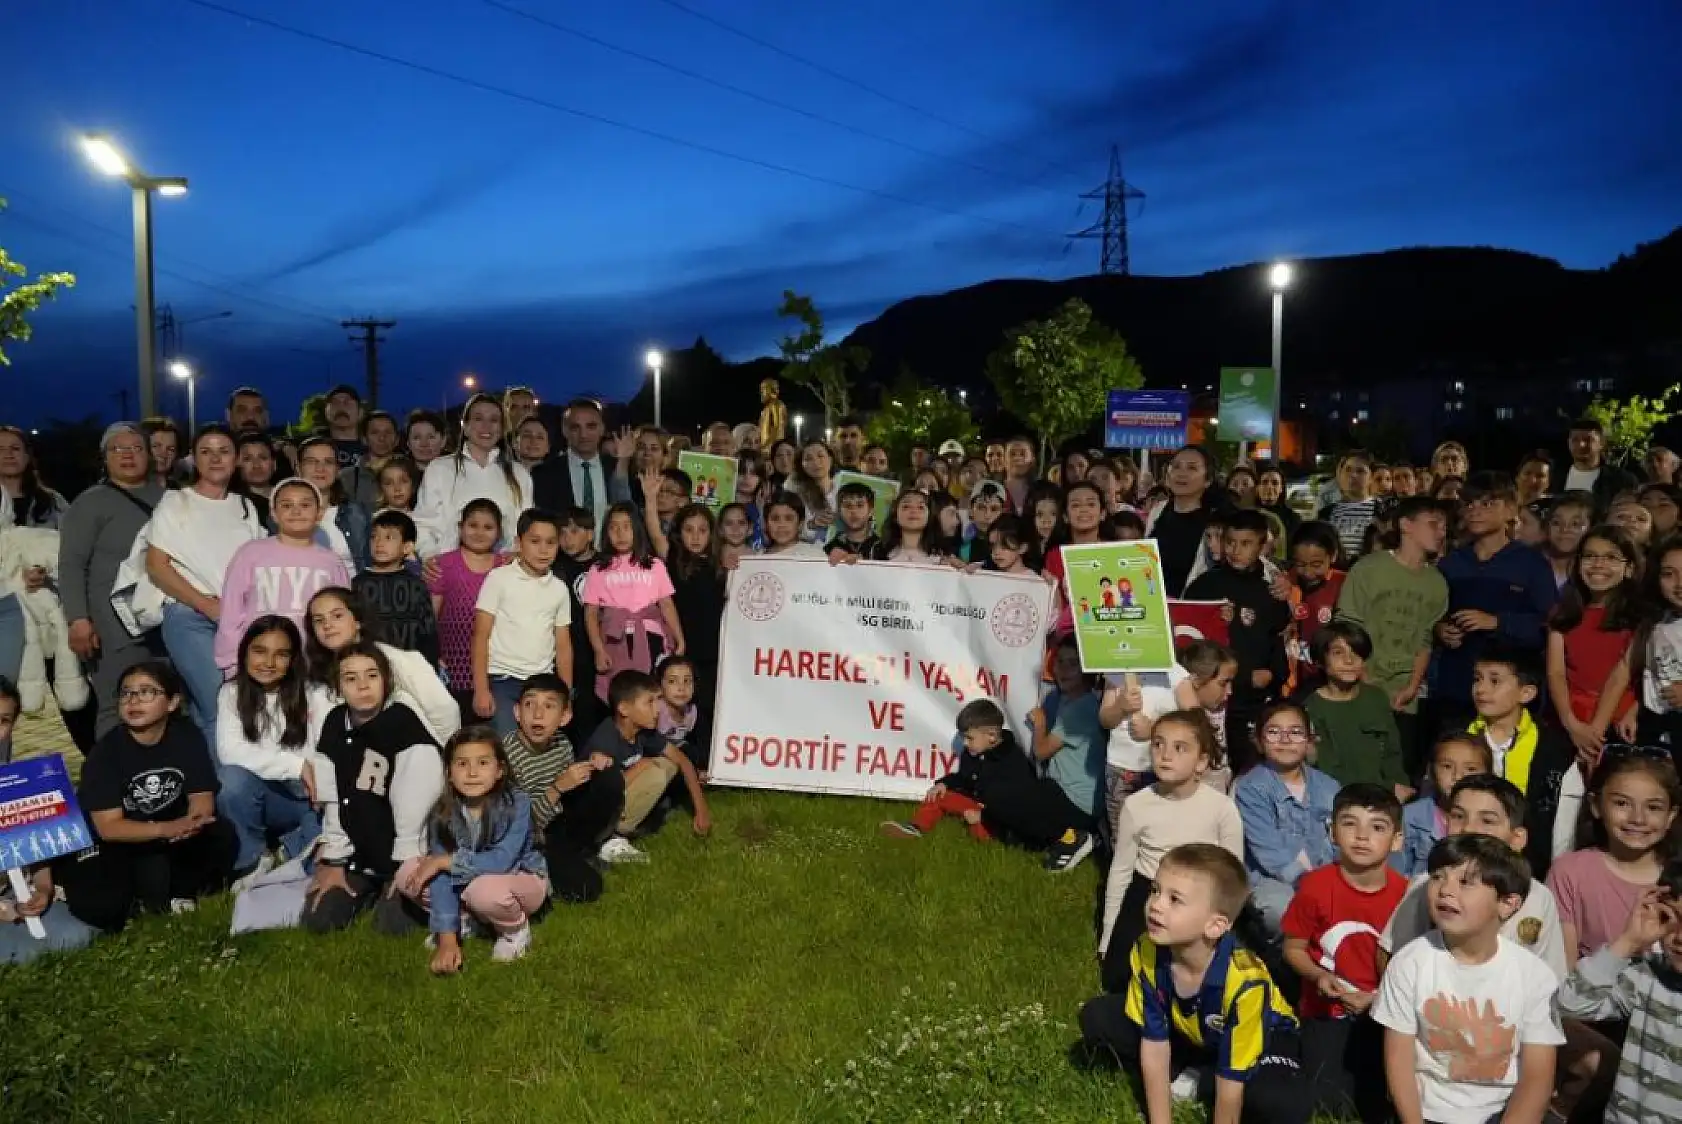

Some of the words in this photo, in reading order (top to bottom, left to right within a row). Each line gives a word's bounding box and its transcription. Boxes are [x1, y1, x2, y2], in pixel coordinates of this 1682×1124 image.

[754, 647, 912, 685] HAREKEİ
[868, 699, 905, 732] VE
[355, 748, 390, 796] R
[724, 734, 847, 772] SPORTİF
